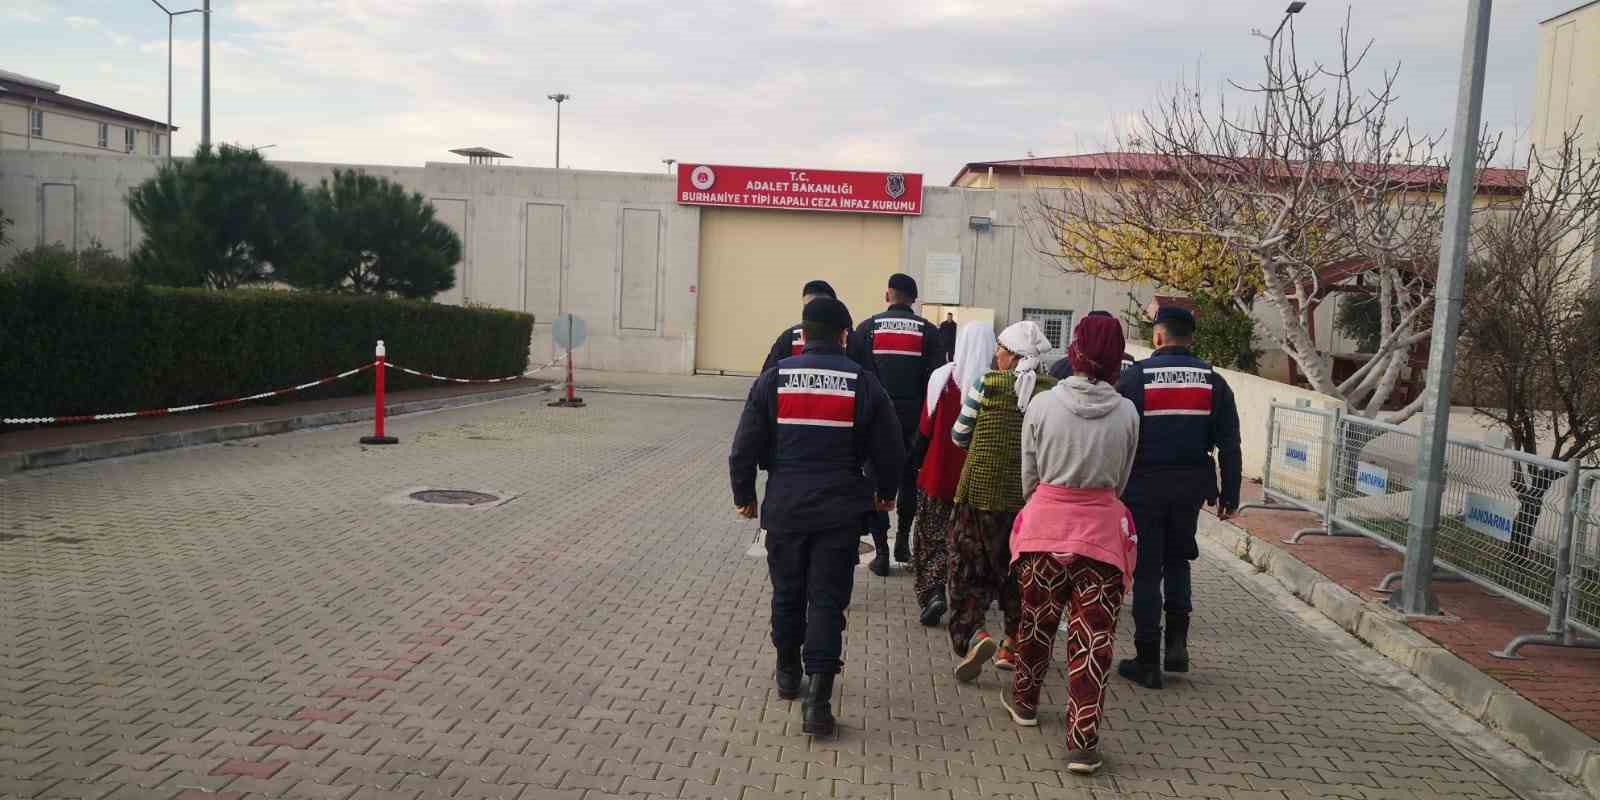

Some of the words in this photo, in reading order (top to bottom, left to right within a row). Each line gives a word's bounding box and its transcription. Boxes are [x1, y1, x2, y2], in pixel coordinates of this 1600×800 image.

[789, 171, 810, 182] T.C.
[746, 181, 790, 193] ADALET
[792, 182, 854, 195] BAKANLIĞI
[682, 191, 740, 203] BURHANİYE
[743, 194, 751, 204] T
[752, 194, 771, 205] TİPİ
[772, 196, 809, 207] KAPALI
[811, 197, 838, 208] CEZA
[840, 196, 871, 209] İNFAZ
[872, 200, 916, 211] KURUMU
[785, 373, 849, 391] JANDARMA
[1151, 370, 1207, 384] JANDARMA
[1359, 470, 1386, 489] JANDARMA
[1468, 506, 1511, 533] JANDARMA
